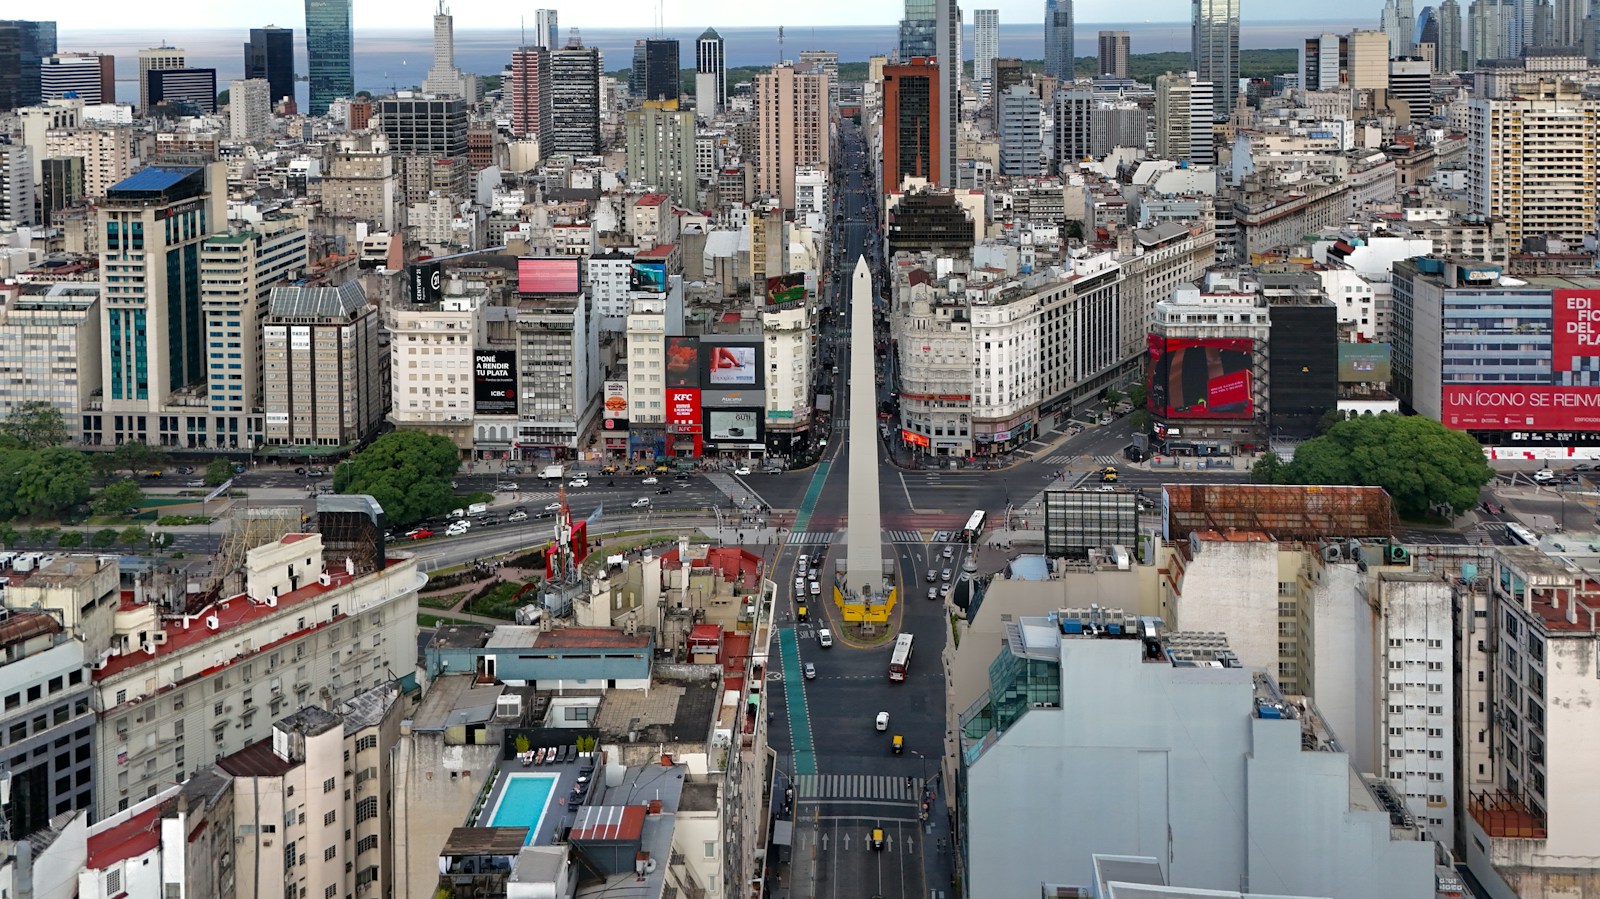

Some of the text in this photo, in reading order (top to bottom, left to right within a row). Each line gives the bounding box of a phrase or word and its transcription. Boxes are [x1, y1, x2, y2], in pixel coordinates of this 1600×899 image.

[1566, 297, 1591, 310] EDI
[1566, 321, 1595, 334] DEL
[673, 393, 693, 401] KFC
[1450, 393, 1472, 406] UN
[1475, 390, 1526, 406] ÍCONO
[1529, 393, 1550, 406] SE
